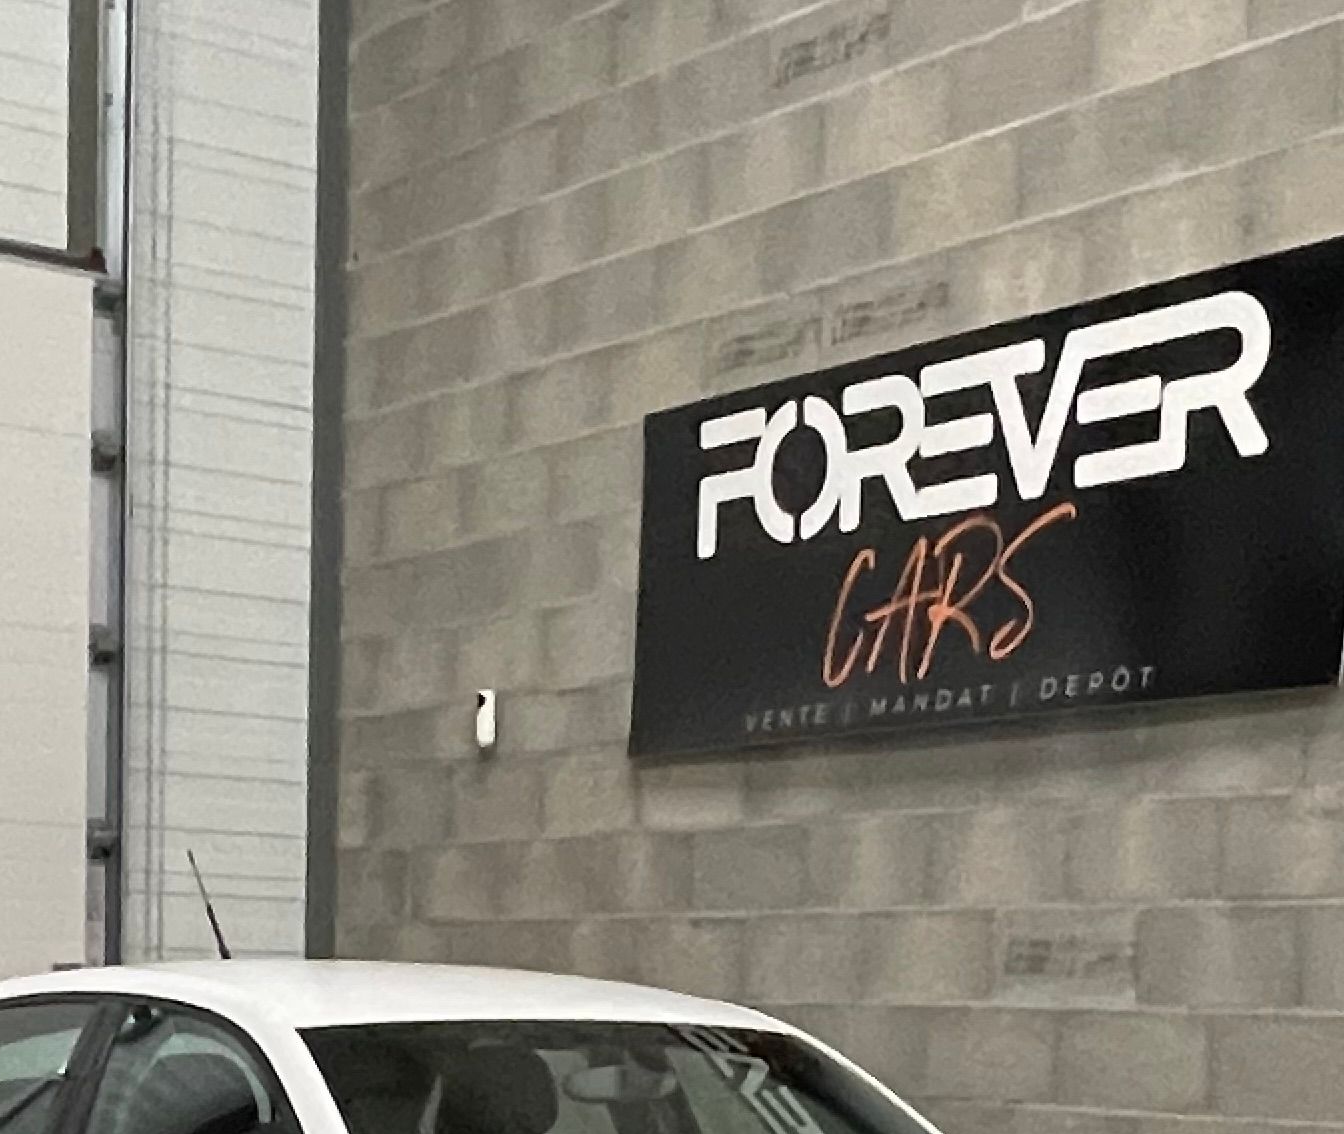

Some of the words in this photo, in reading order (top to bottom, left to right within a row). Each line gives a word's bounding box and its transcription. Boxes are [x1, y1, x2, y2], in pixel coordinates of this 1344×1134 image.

[697, 290, 1272, 559] FOREVER
[822, 502, 1077, 688] CARS
[744, 702, 829, 732] VENTE
[869, 683, 994, 717] MANDAT
